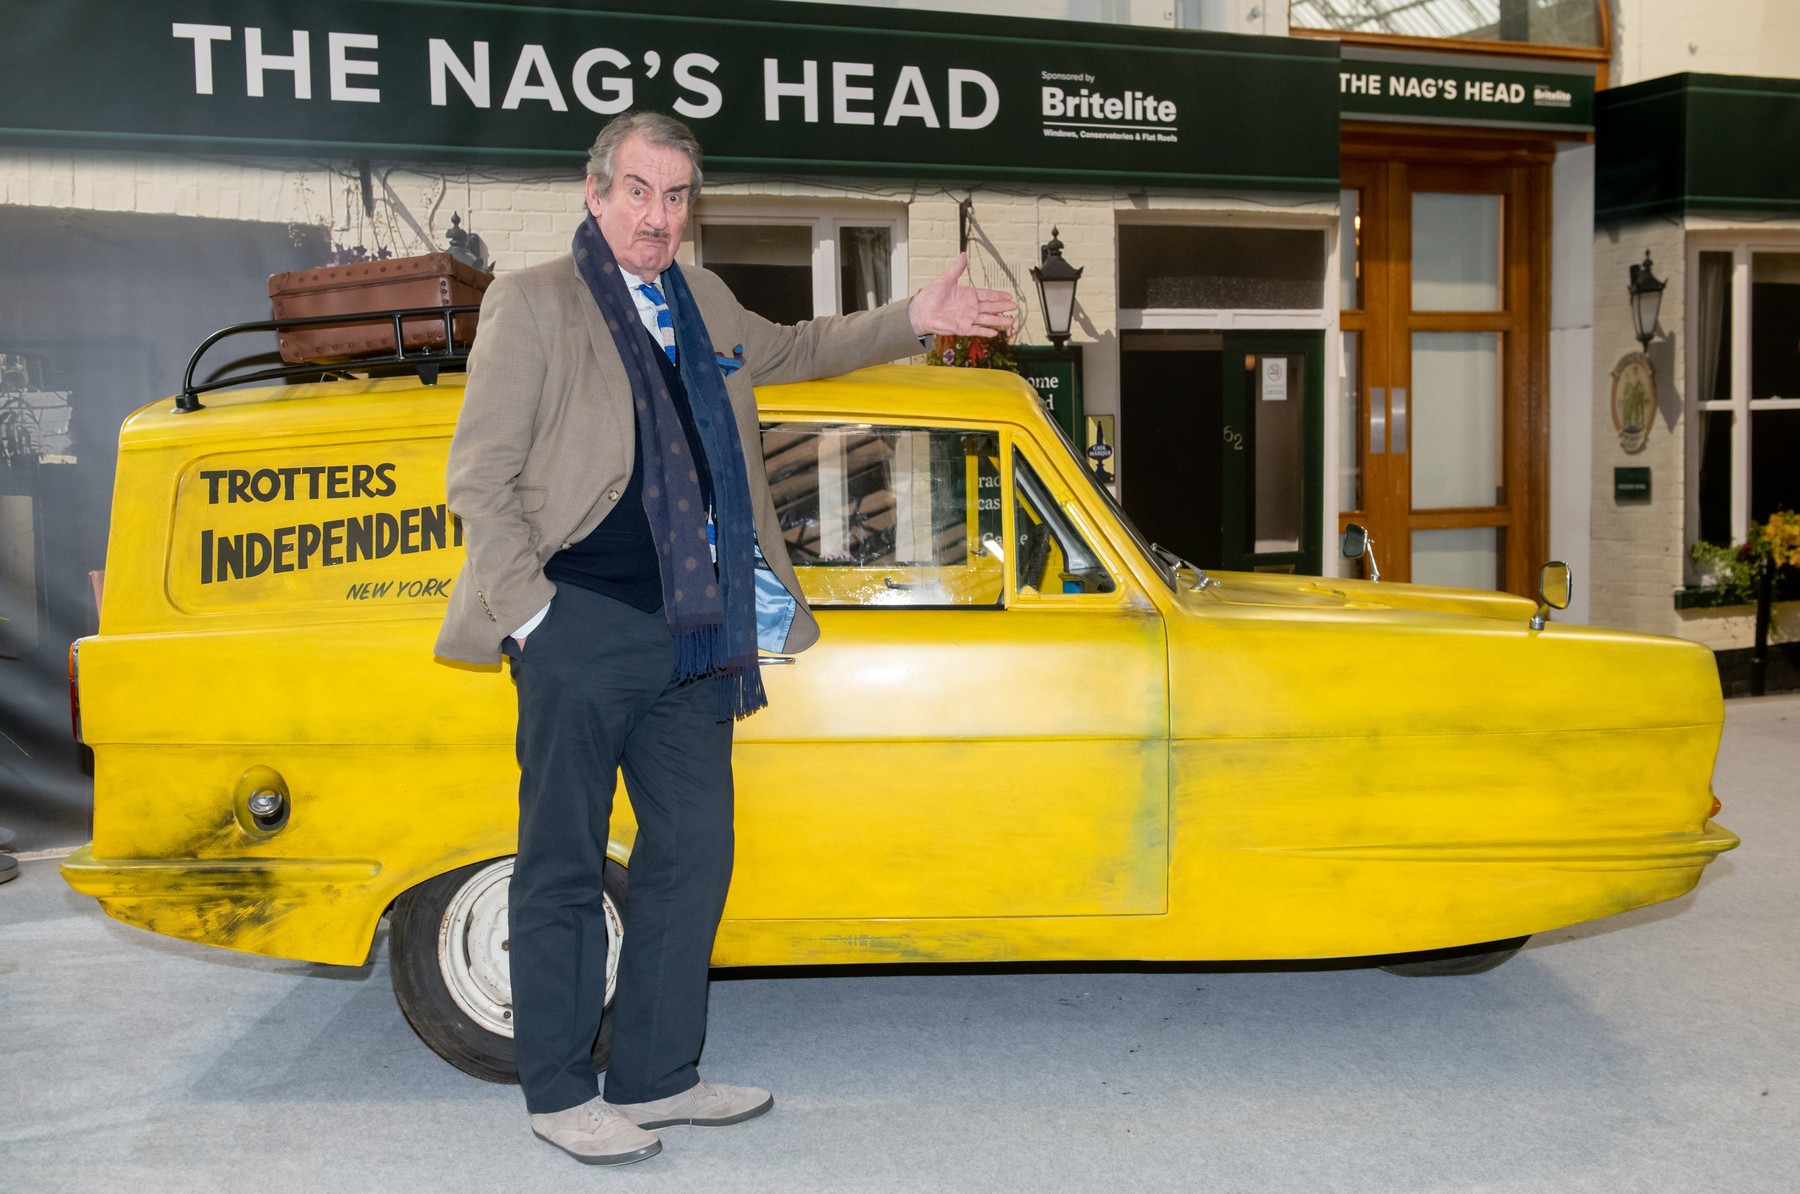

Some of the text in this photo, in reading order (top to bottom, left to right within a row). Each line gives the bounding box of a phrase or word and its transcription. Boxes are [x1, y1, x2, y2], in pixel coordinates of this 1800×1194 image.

[172, 23, 1000, 130] THE NAG’S HEAD
[1041, 71, 1095, 83] Sponsored by
[1339, 73, 1525, 103] THE NAG’S HEAD
[1042, 86, 1177, 122] Britelite
[1043, 129, 1079, 139] Windows,
[1080, 130, 1134, 141] Conservatories
[1142, 133, 1156, 141] Flat
[1157, 133, 1178, 142] Roofs
[1223, 425, 1243, 450] 62
[200, 462, 396, 504] TROTTERS
[346, 578, 451, 600] NEW YORK
